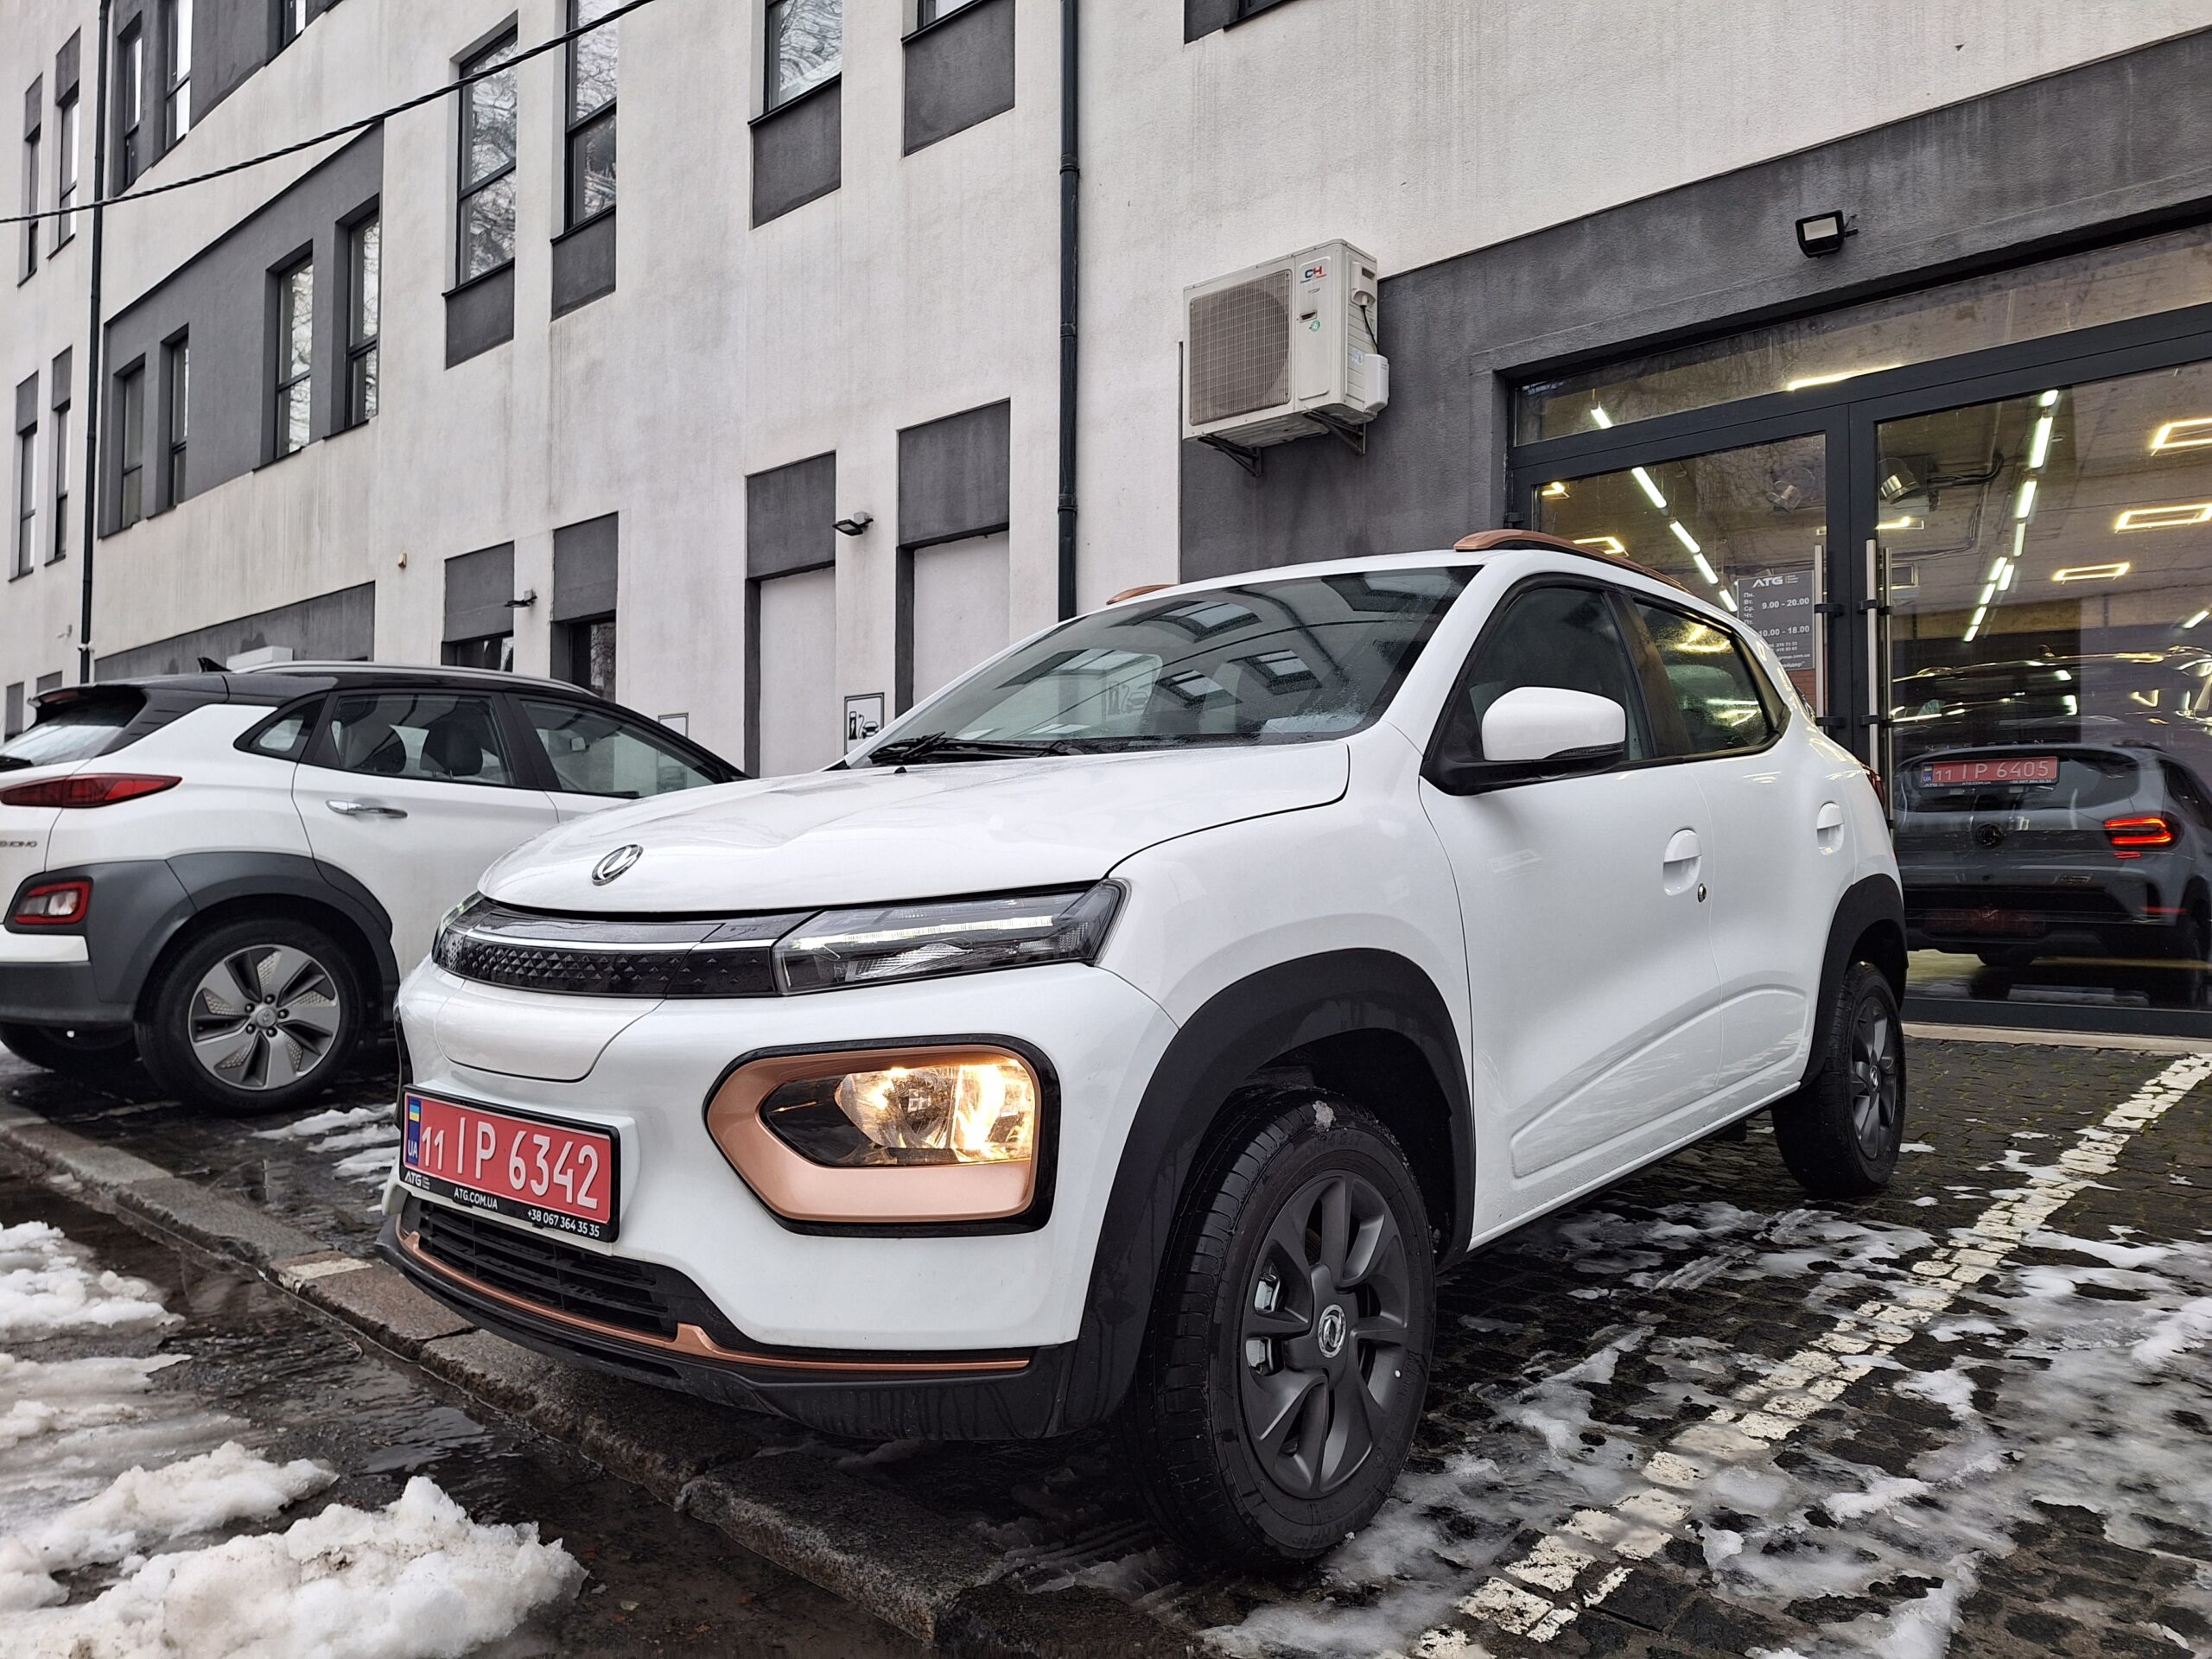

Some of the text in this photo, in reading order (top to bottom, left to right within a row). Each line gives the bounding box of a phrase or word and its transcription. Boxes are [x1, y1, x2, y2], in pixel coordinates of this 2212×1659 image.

[1304, 265, 1323, 278] CH
[1762, 601, 1779, 610] 9.00
[1786, 597, 1810, 607] 20.00
[1758, 628, 1780, 638] 10.00
[1787, 625, 1810, 634] 18.00
[1936, 760, 2049, 781] 11 IP 6405
[407, 1139, 418, 1159] UA
[422, 1116, 598, 1210] 11 IP 6342
[454, 1187, 498, 1210] ATG.COM.UA
[527, 1209, 601, 1237] +38 067 364 35 35
